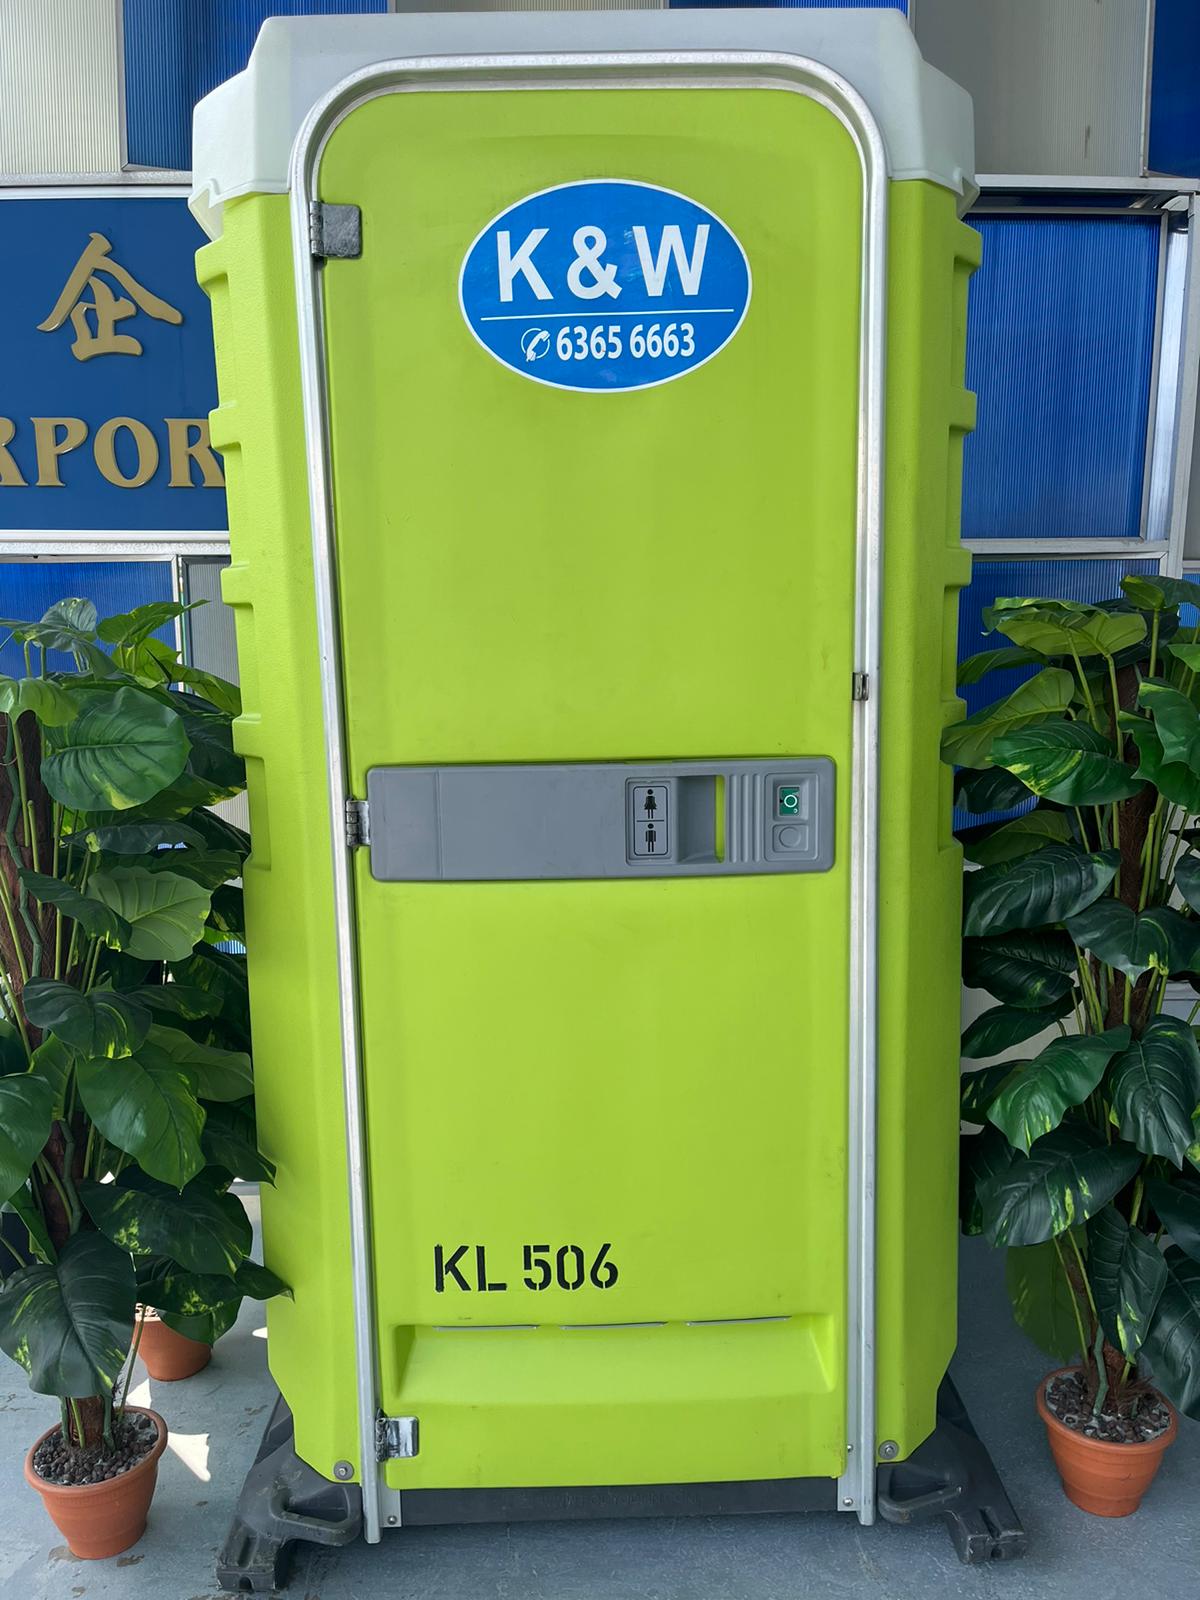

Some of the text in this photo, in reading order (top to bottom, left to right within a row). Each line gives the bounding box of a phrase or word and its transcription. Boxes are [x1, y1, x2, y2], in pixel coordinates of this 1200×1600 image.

[496, 224, 710, 302] K & W
[36, 232, 183, 361] 企
[556, 322, 696, 361] 6365 6663
[434, 1243, 619, 1293] KL 506
